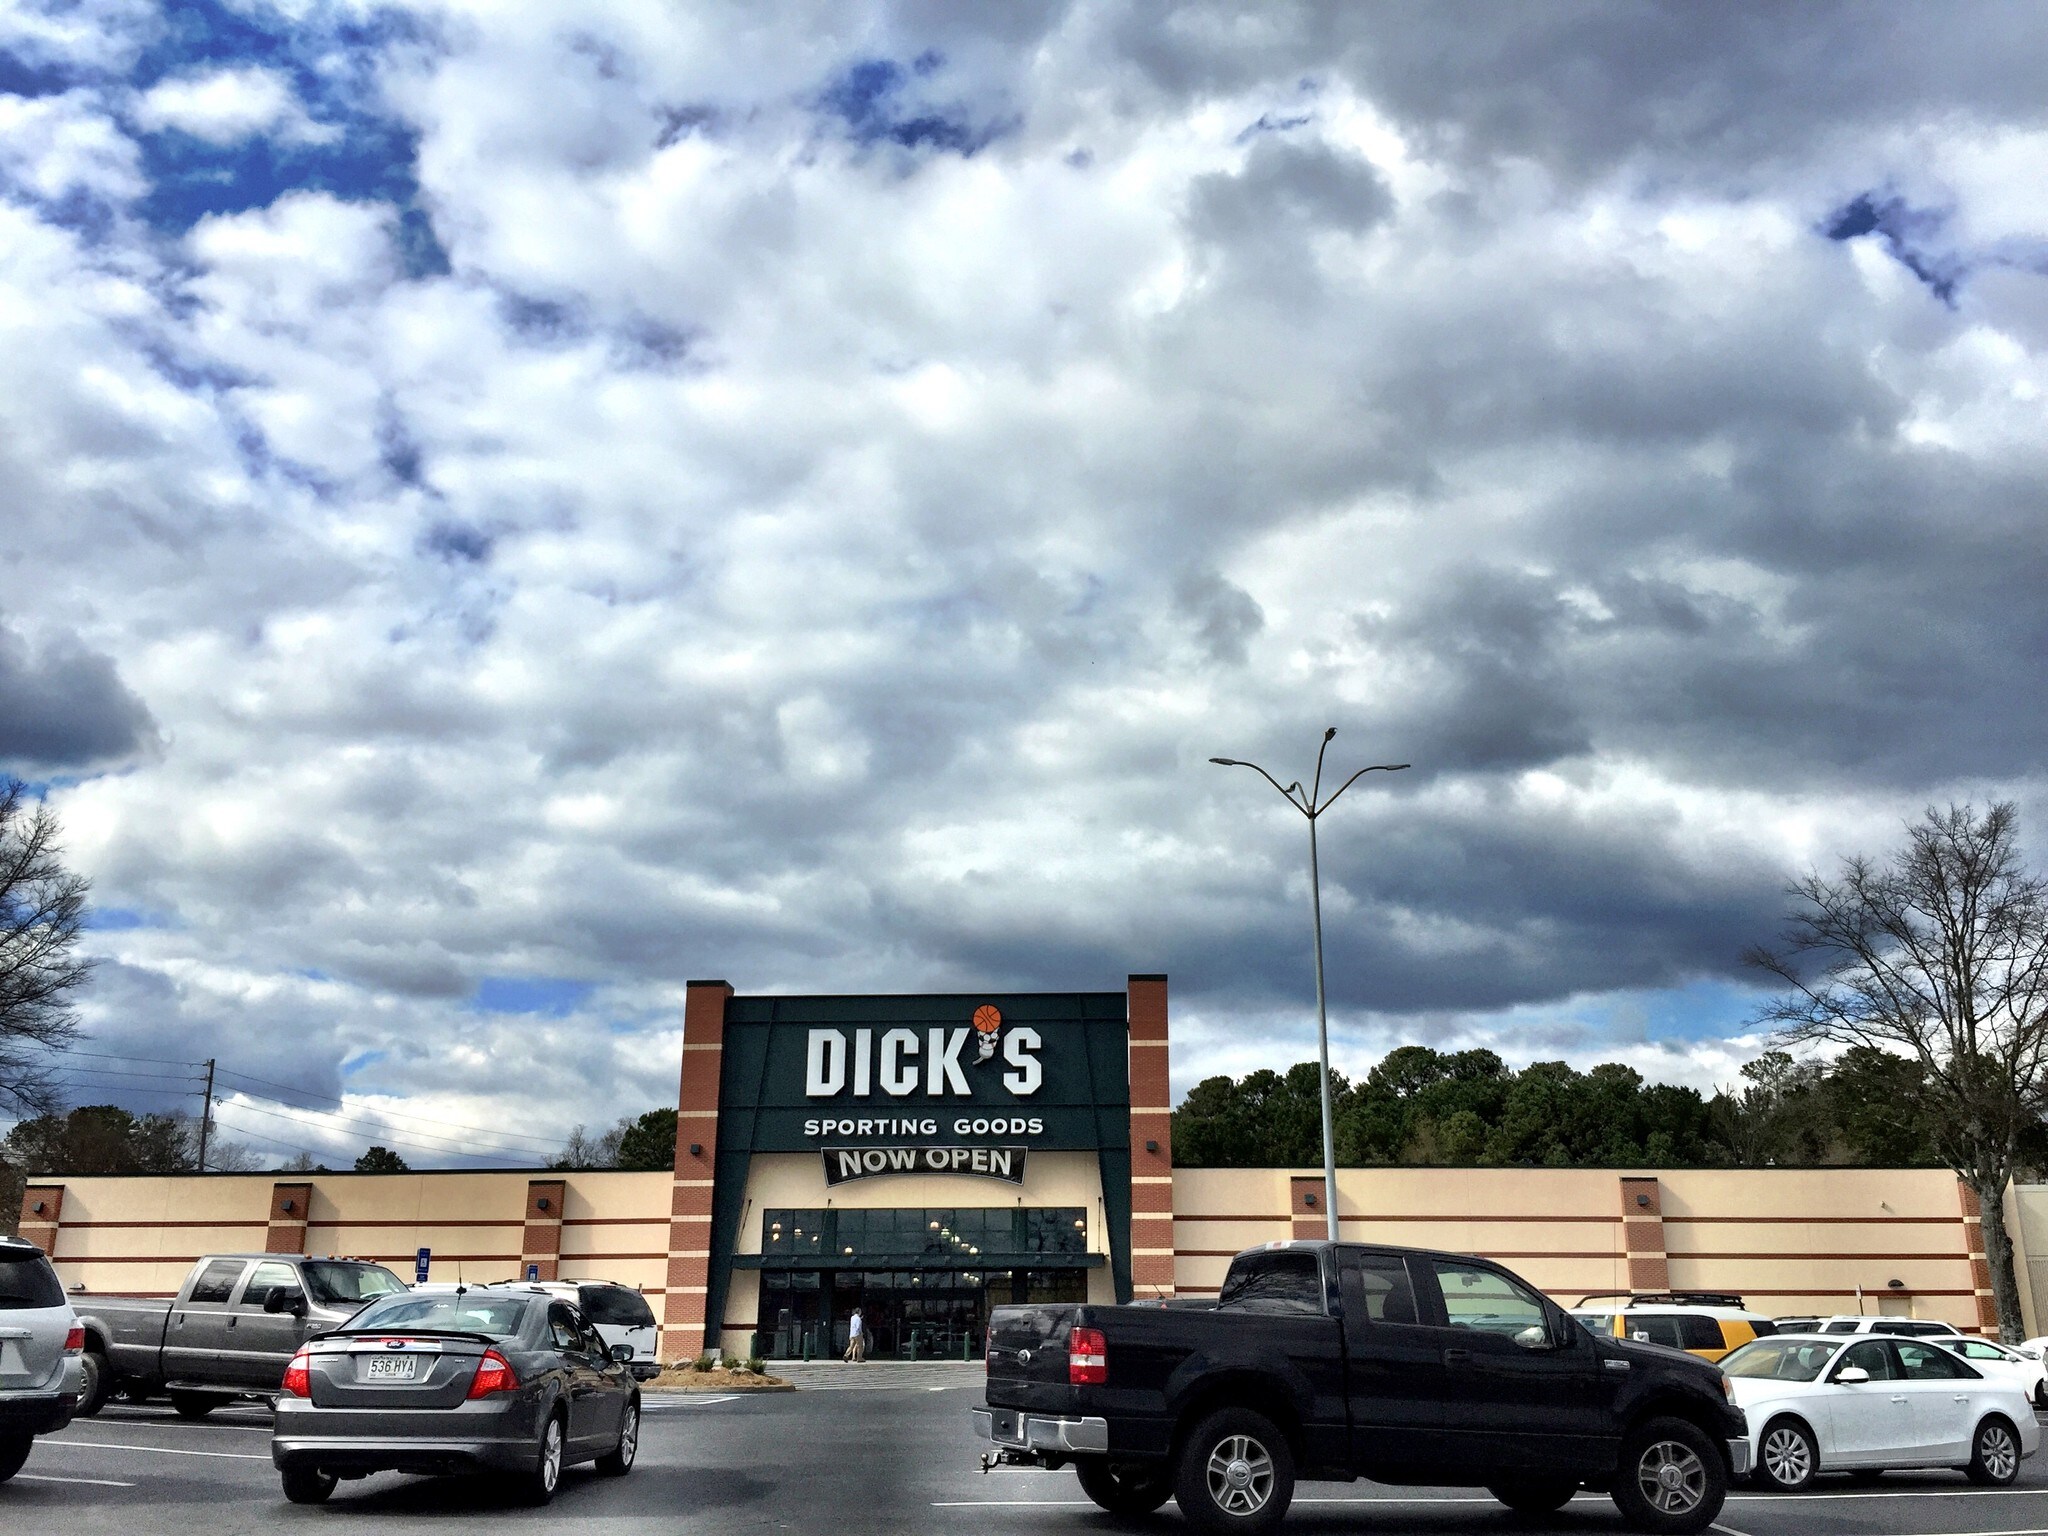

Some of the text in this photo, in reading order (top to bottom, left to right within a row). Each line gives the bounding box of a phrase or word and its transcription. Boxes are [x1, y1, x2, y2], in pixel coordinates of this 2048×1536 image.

[806, 1005, 1043, 1097] DICK'S
[803, 1117, 1044, 1136] SPORTING GOODS
[838, 1149, 1012, 1178] NOW OPEN
[370, 1360, 413, 1373] 536 HYA
